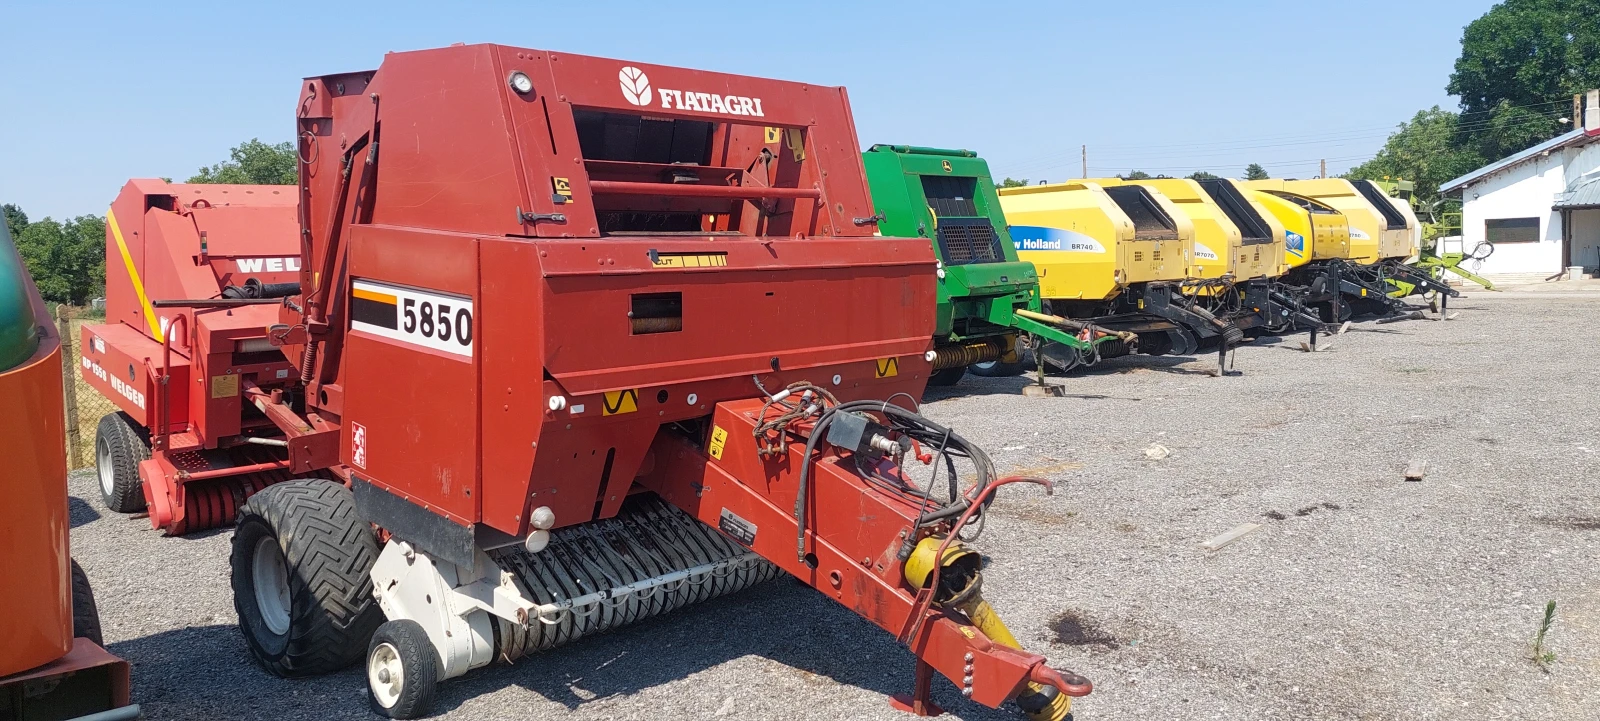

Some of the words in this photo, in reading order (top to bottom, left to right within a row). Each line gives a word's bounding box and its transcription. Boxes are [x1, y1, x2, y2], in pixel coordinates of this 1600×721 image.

[657, 88, 765, 117] FIATAGRI
[1023, 238, 1061, 250] Holland
[403, 297, 473, 347] 5850
[110, 373, 146, 410] WELGER
